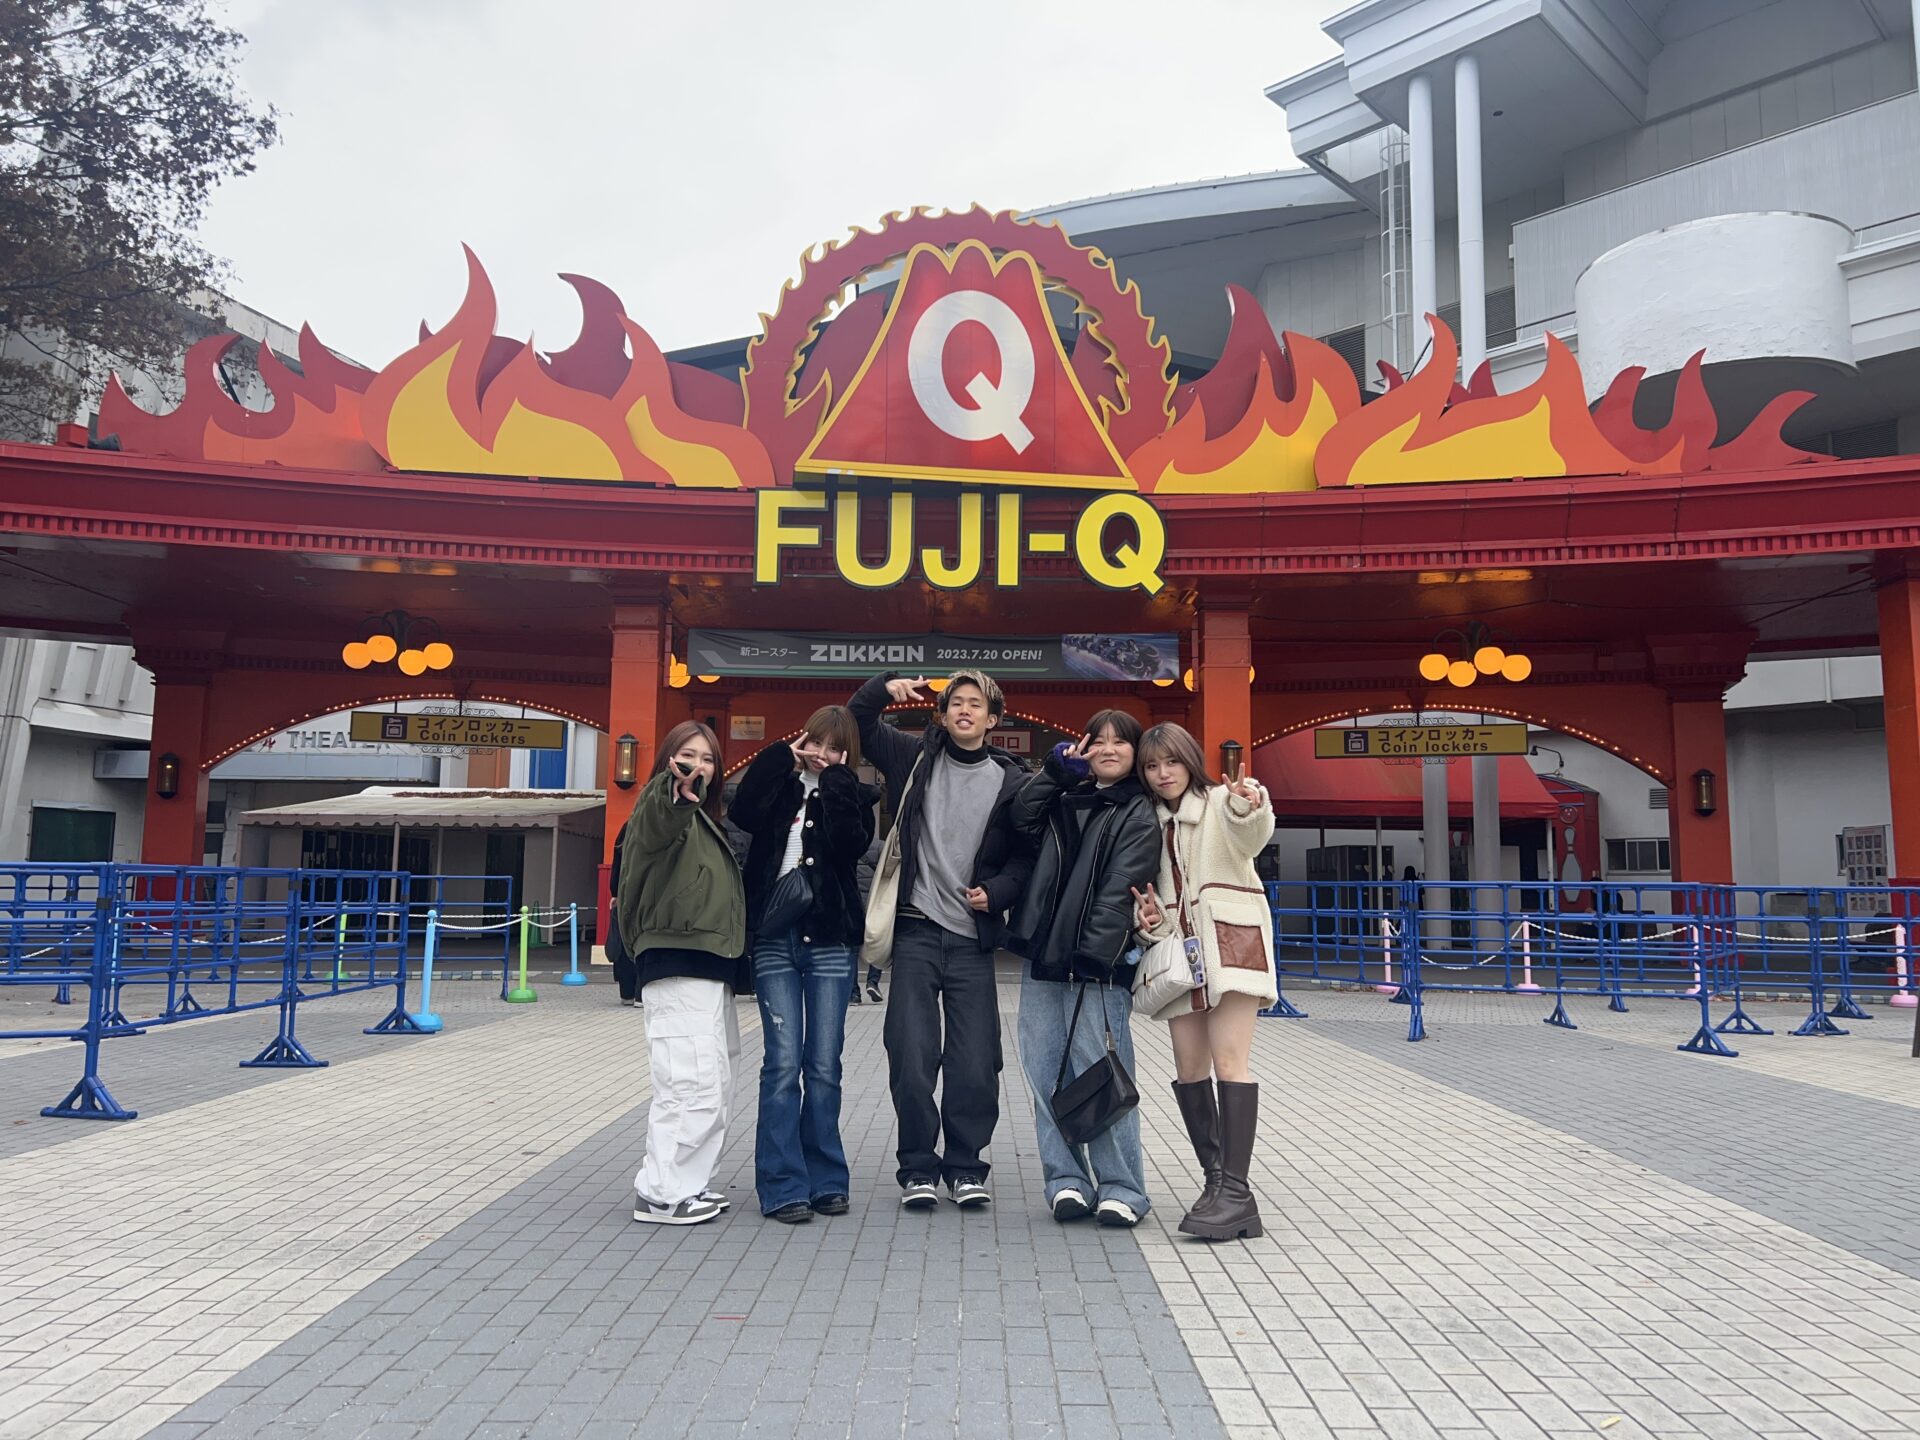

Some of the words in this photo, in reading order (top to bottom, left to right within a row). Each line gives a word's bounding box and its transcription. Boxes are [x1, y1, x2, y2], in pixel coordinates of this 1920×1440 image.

[908, 290, 1035, 455] Q
[755, 489, 1167, 597] FUJI-Q
[740, 646, 799, 657] 新コースター
[810, 644, 925, 662] ZOKKON
[936, 648, 999, 660] 2023.7.20
[1001, 649, 1043, 661] OPEN!
[417, 717, 531, 733] コインロッカー
[286, 730, 391, 750] THEA
[420, 729, 456, 742] Coin
[464, 731, 526, 744] lockers
[1377, 727, 1493, 742] コインロッカー
[1381, 741, 1418, 753] Coin
[1425, 740, 1489, 752] lockers
